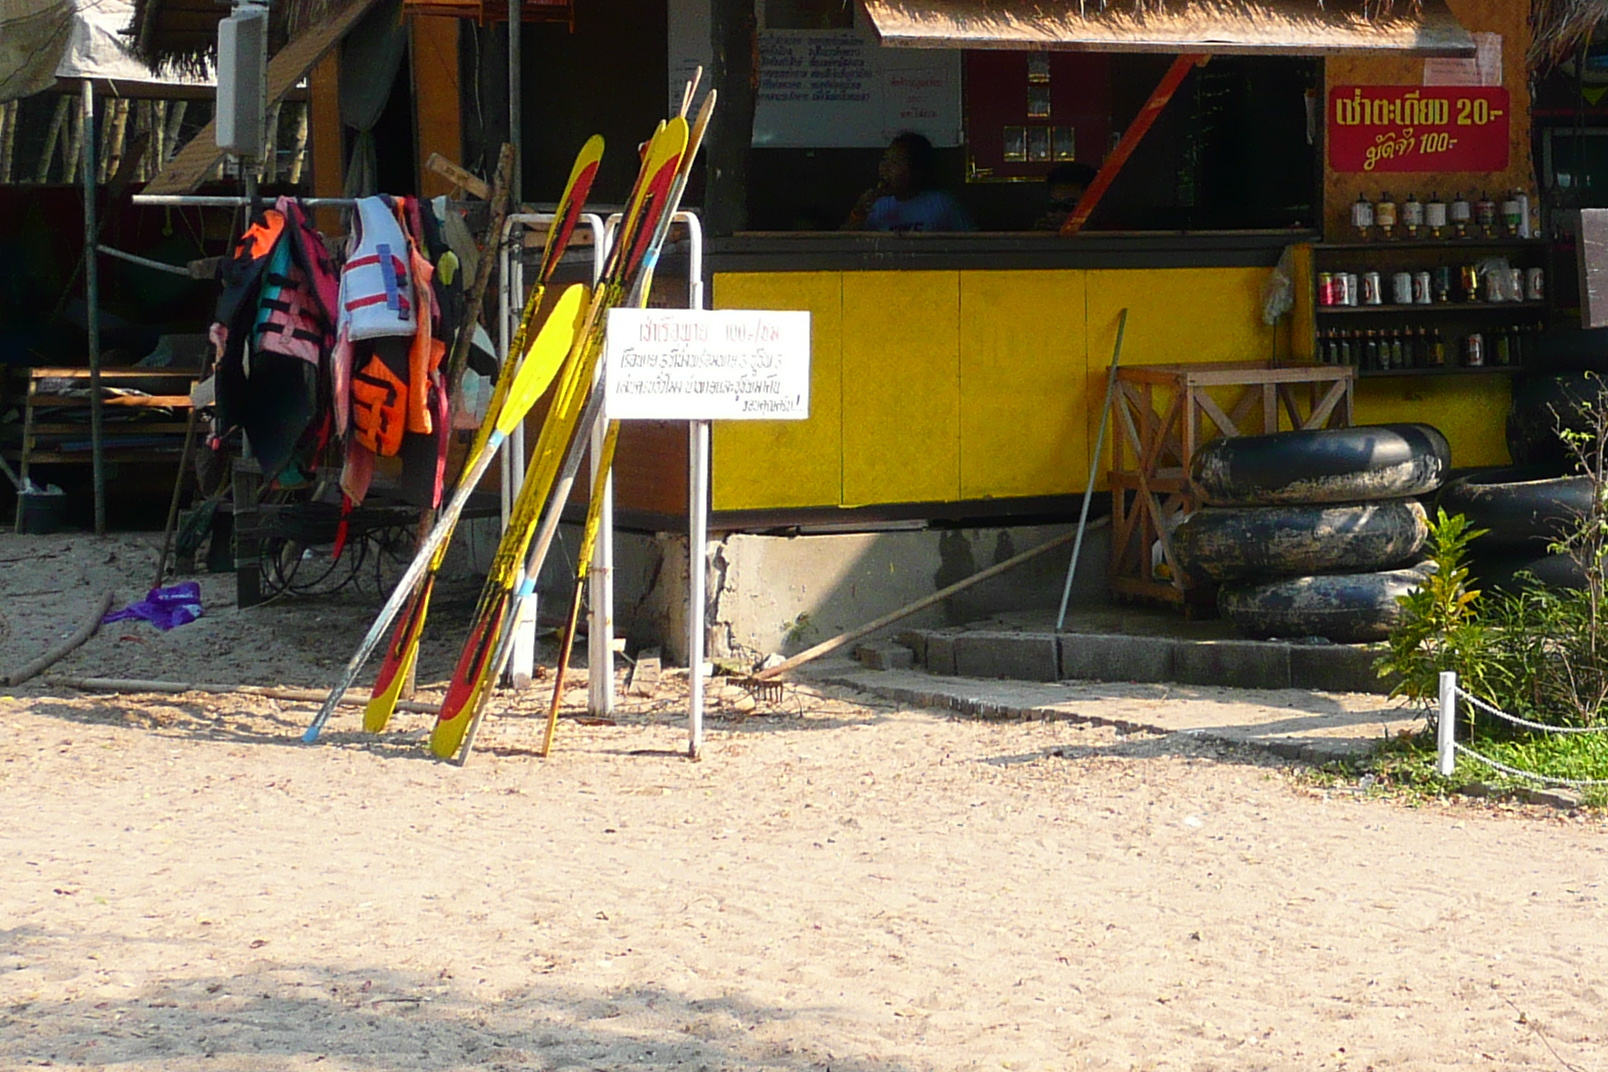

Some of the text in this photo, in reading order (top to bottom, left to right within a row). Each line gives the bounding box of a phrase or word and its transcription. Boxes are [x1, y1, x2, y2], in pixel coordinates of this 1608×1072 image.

[1336, 88, 1449, 125] เช่าตะเกียง
